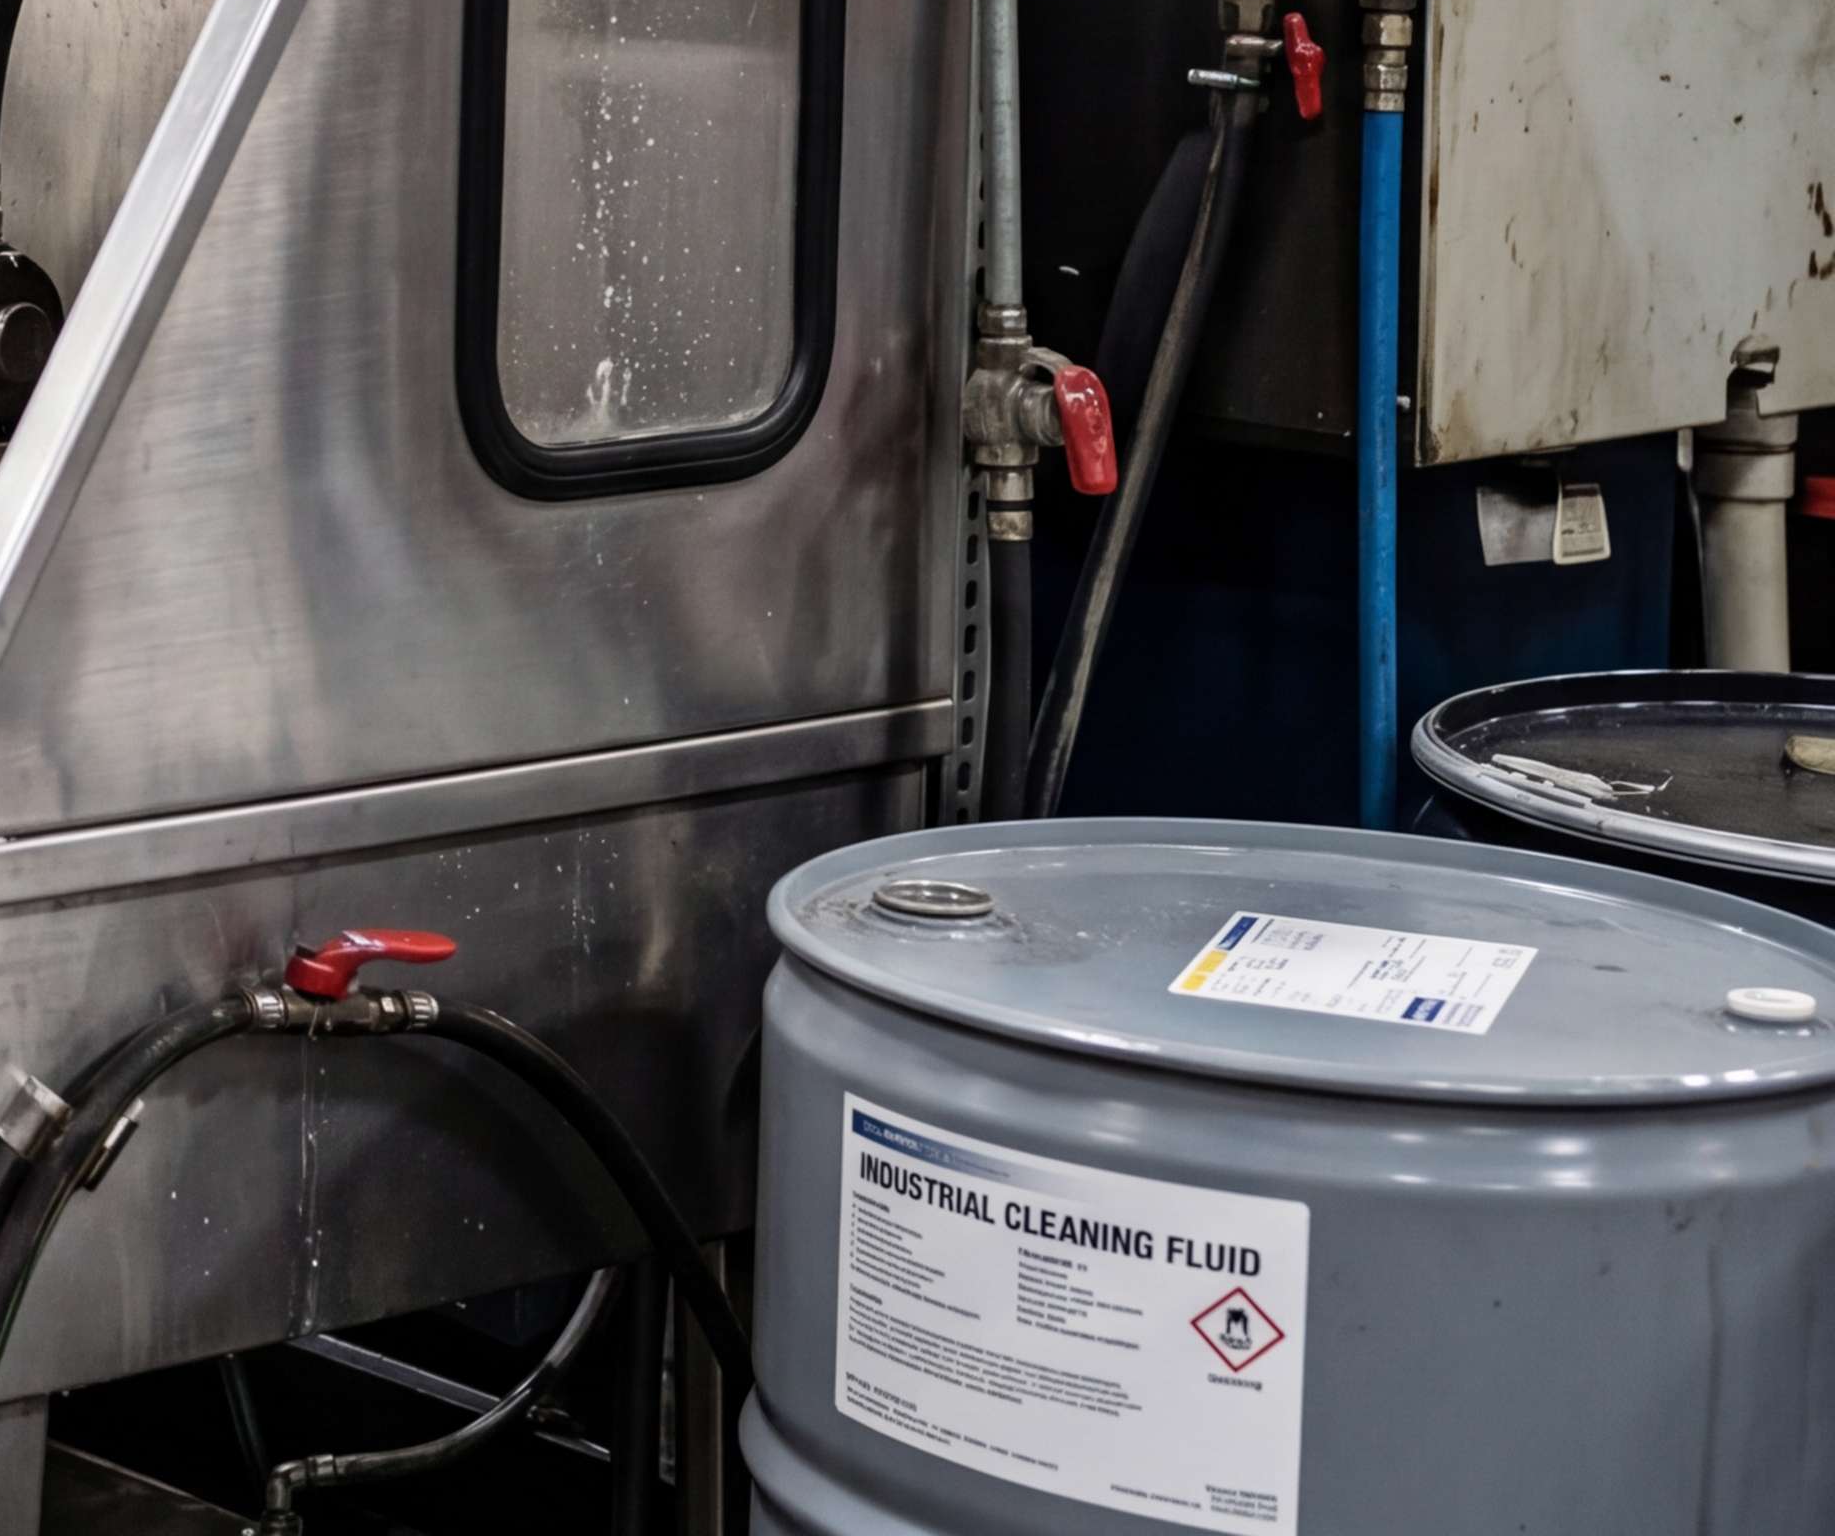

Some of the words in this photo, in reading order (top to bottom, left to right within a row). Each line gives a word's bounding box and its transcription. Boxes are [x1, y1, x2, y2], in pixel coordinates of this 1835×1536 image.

[859, 1151, 996, 1225] INDUSTRIAL
[1003, 1201, 1154, 1260] CLEANING
[1166, 1236, 1262, 1278] FLUID
